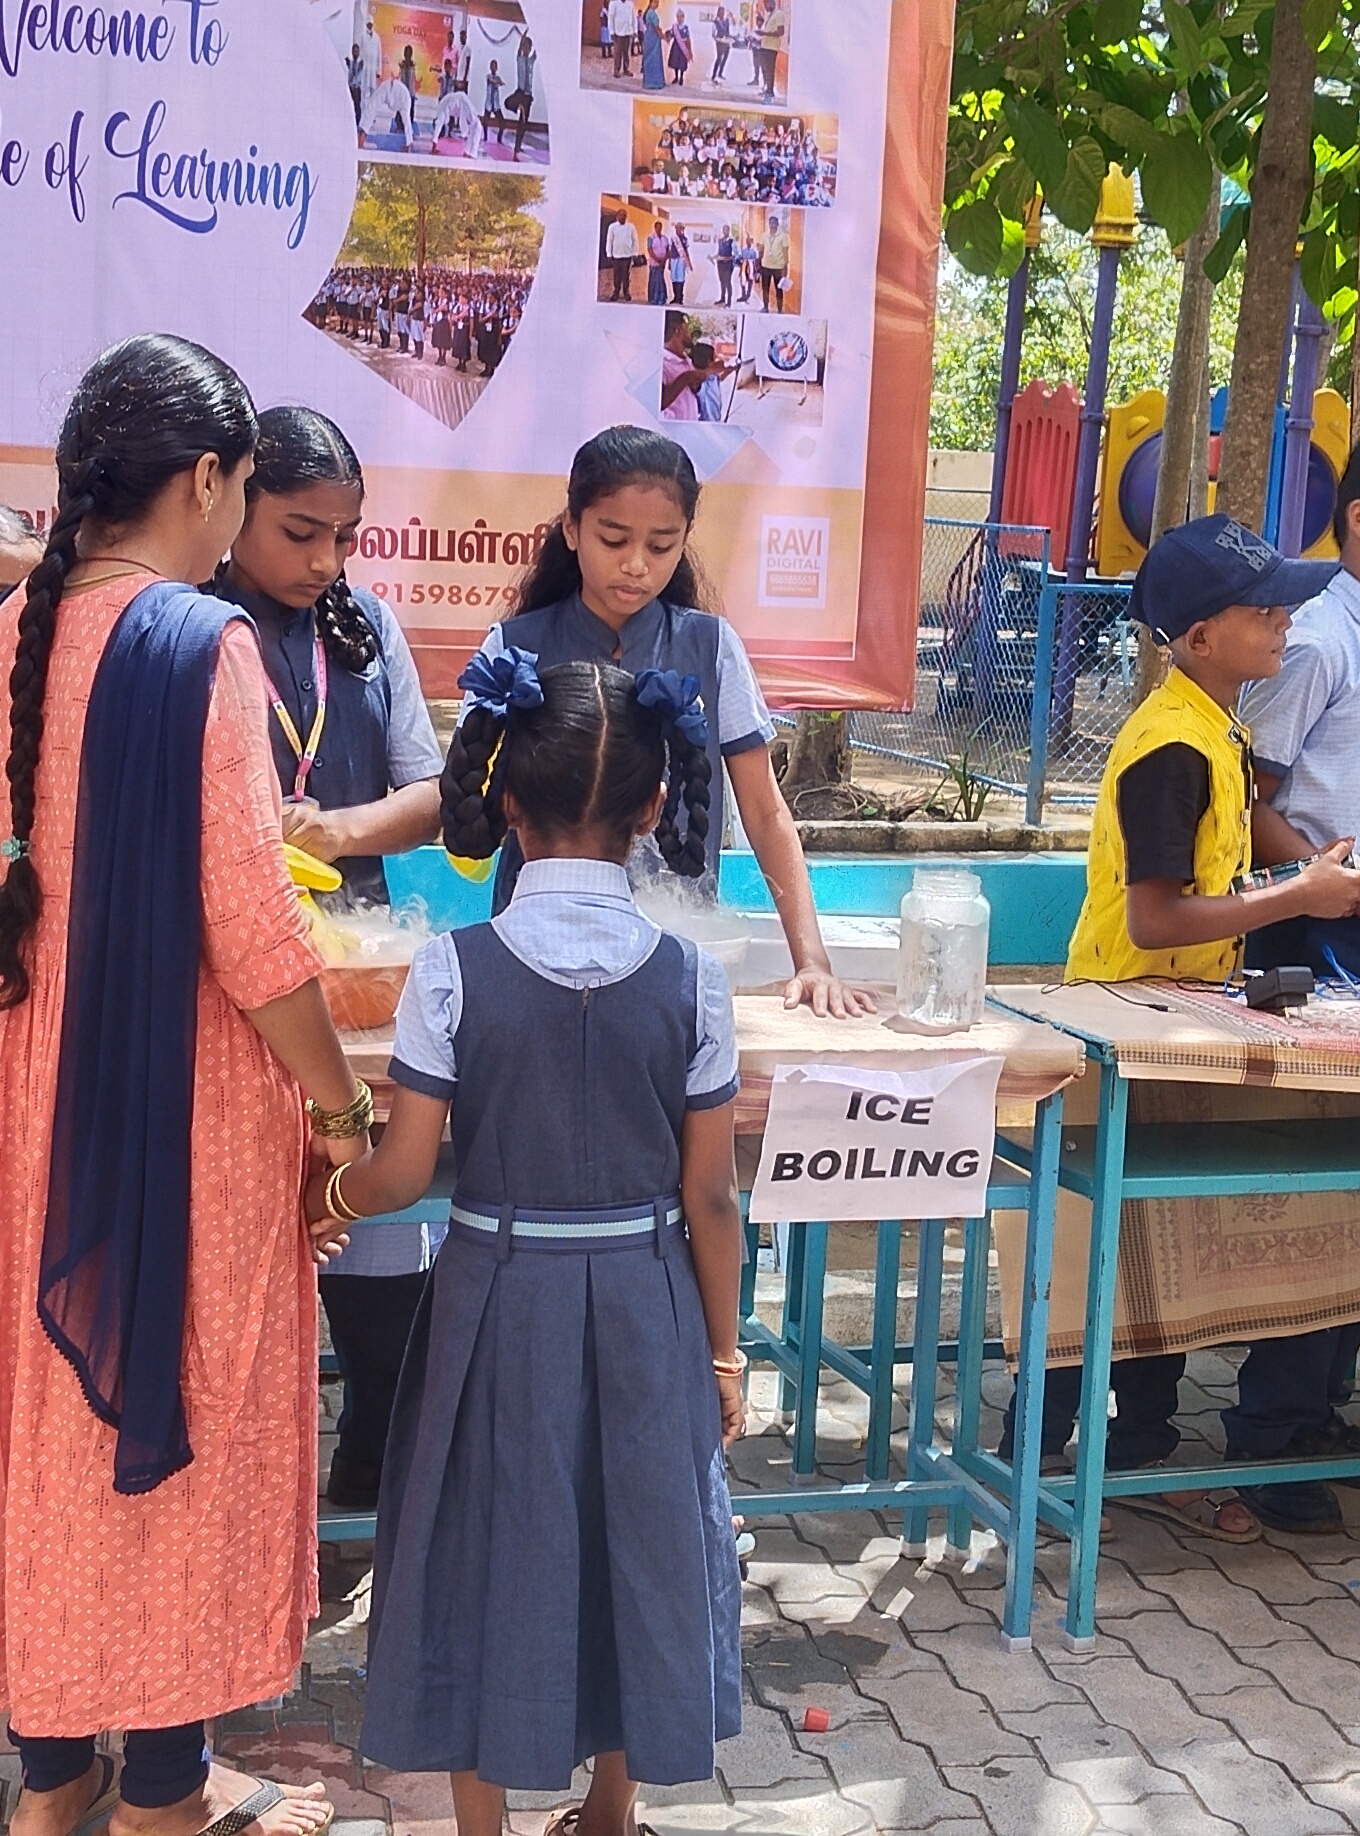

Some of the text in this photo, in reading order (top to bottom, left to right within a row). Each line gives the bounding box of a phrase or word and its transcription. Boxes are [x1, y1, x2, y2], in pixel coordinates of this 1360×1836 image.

[45, 111, 89, 223] of
[104, 100, 319, 250] Learning
[767, 527, 823, 557] RAVI
[766, 557, 821, 570] DIGITAL
[371, 582, 519, 607] 91598679
[846, 1091, 935, 1126] ICE
[770, 1147, 980, 1183] BOILING
